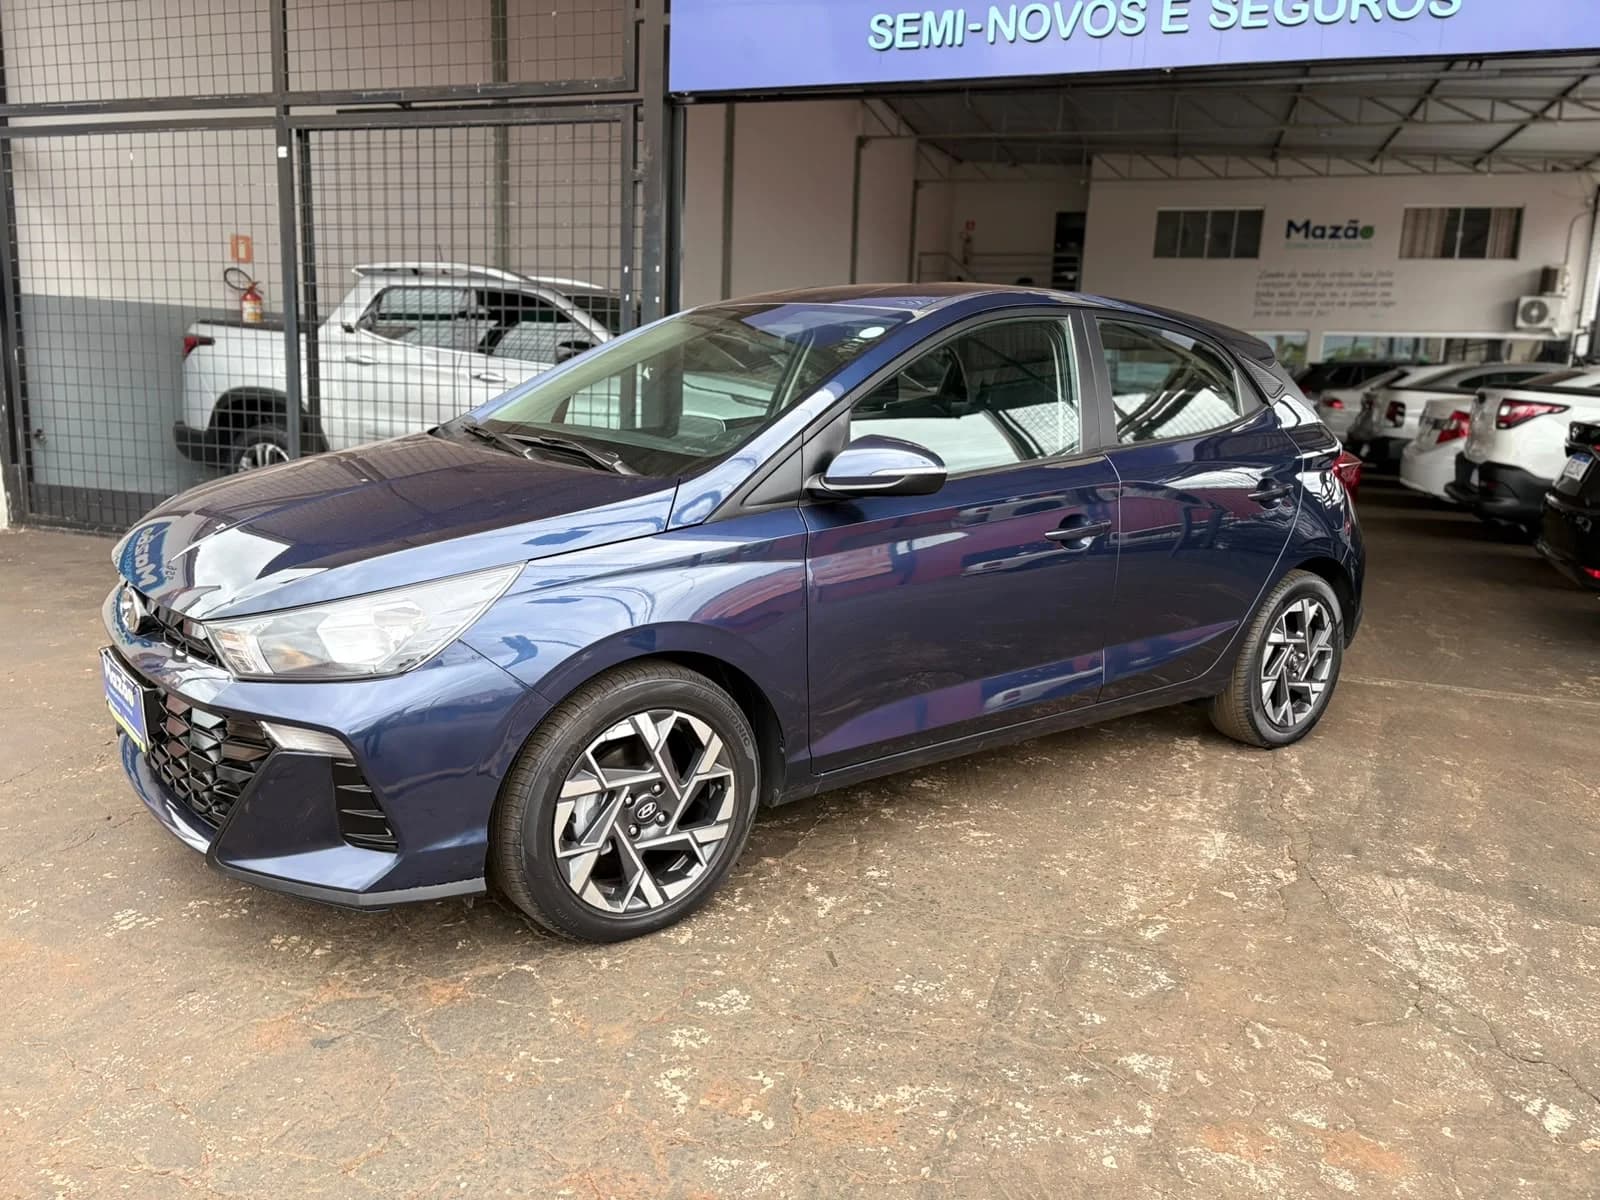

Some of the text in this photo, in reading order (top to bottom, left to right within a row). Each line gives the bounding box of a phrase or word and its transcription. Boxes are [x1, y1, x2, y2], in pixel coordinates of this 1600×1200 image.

[868, 0, 1147, 50] SEMI-NOVOS
[1161, 0, 1189, 34] E
[1285, 219, 1375, 240] Mazão
